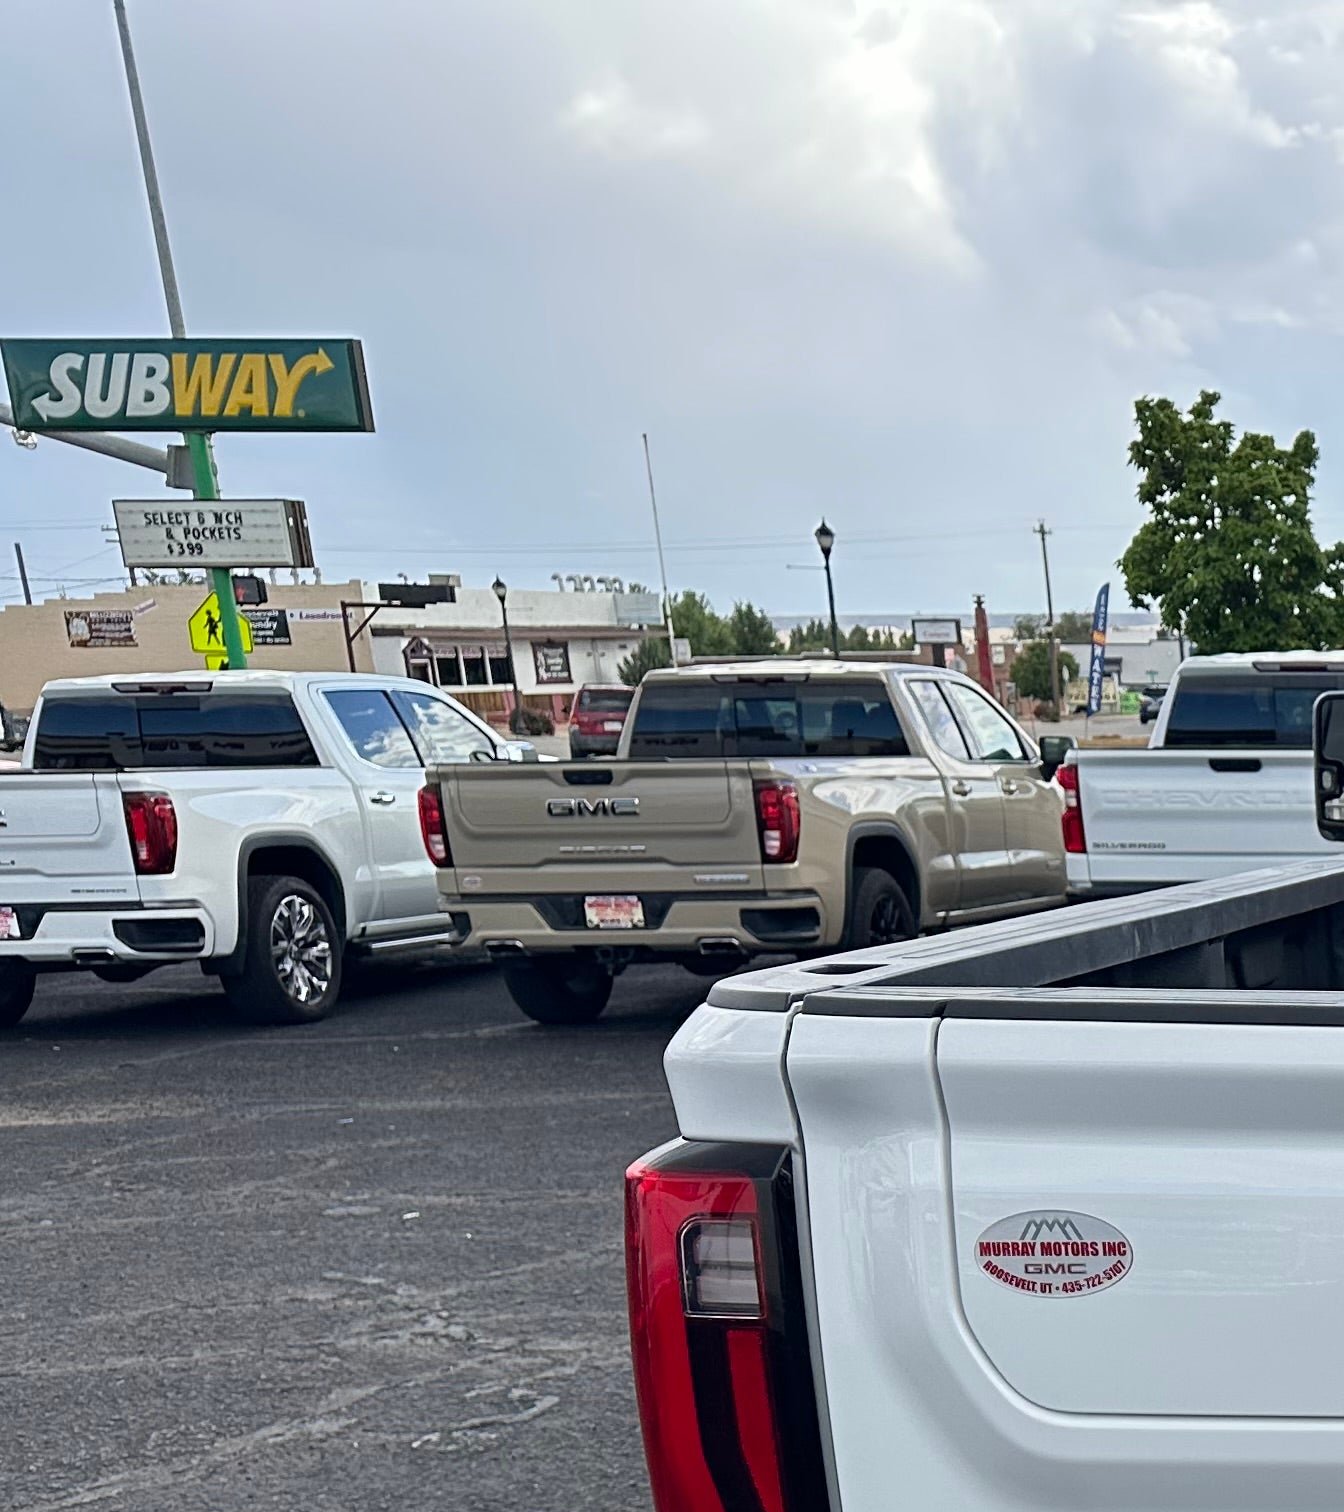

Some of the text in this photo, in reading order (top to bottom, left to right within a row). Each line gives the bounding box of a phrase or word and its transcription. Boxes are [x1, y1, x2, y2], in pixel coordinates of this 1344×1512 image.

[31, 347, 335, 422] SUBWAY
[144, 512, 190, 526] SELECT
[183, 527, 242, 541] POCKETS
[1101, 788, 1315, 807] CHEVROL
[546, 798, 641, 818] GMC
[979, 1241, 1127, 1257] MURRAY MOTORS INC
[983, 1259, 1126, 1294] ROOSEVELT, UT 435-722-5107
[1024, 1263, 1087, 1274] GMC
